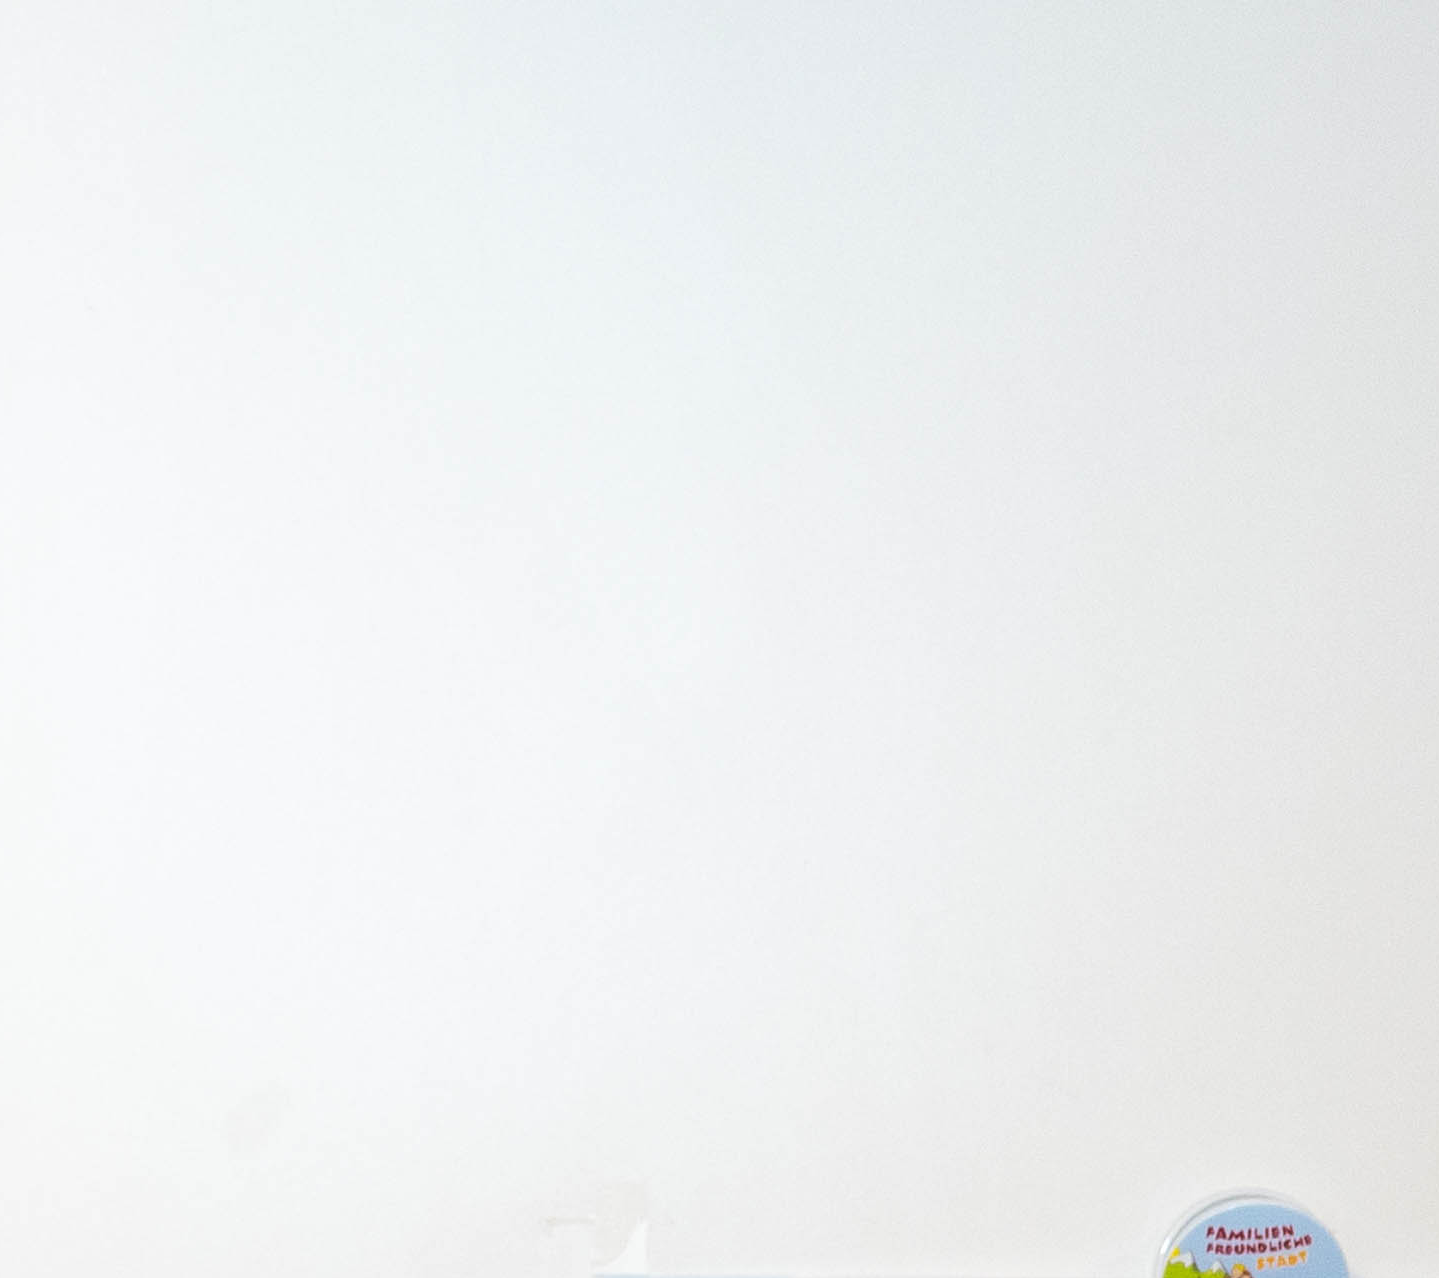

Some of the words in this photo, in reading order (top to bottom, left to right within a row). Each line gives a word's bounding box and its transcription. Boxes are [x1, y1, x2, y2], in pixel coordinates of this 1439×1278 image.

[1206, 1225, 1295, 1242] FAMILIEN
[1206, 1234, 1313, 1255] FREUNDLICHE
[1256, 1251, 1308, 1270] STADT
